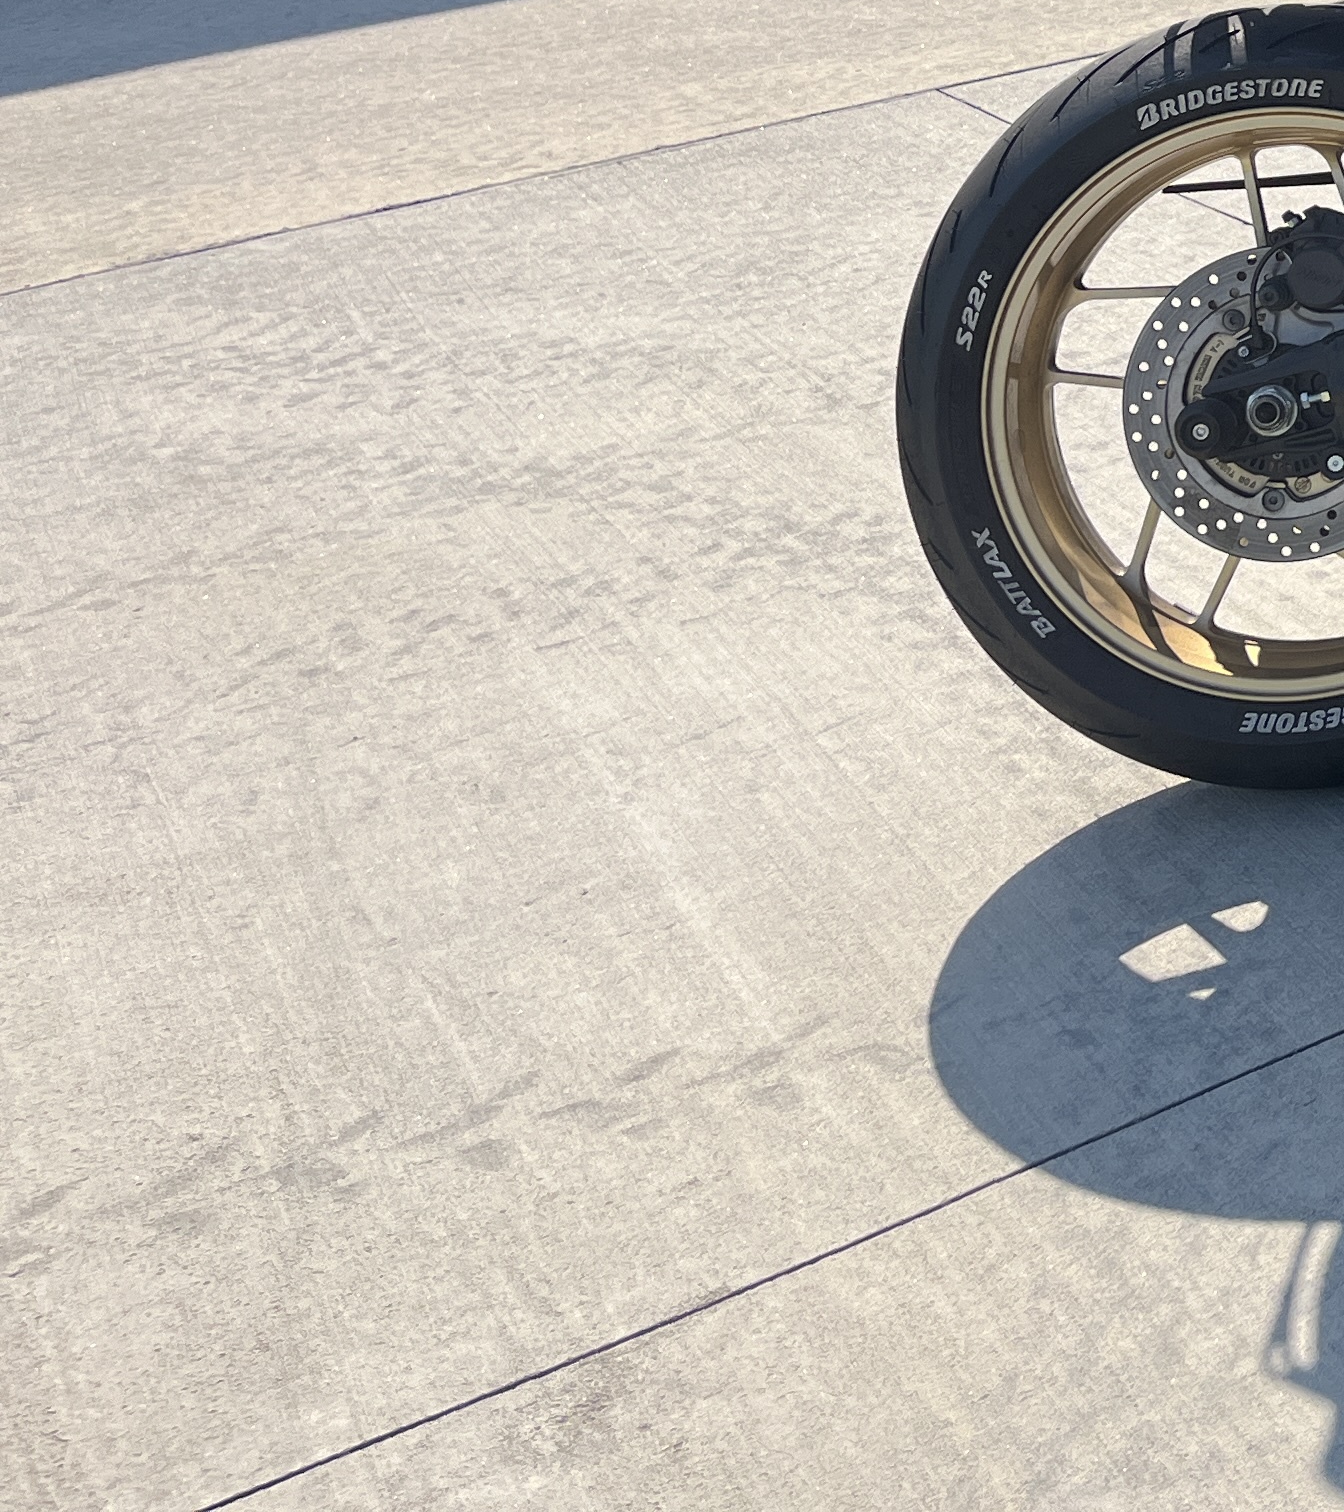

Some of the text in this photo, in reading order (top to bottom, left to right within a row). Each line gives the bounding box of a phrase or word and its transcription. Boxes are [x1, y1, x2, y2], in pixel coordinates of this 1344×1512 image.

[1136, 78, 1324, 130] BRIDGESTONE
[955, 269, 993, 351] S22R
[971, 527, 1056, 640] BATTLAX
